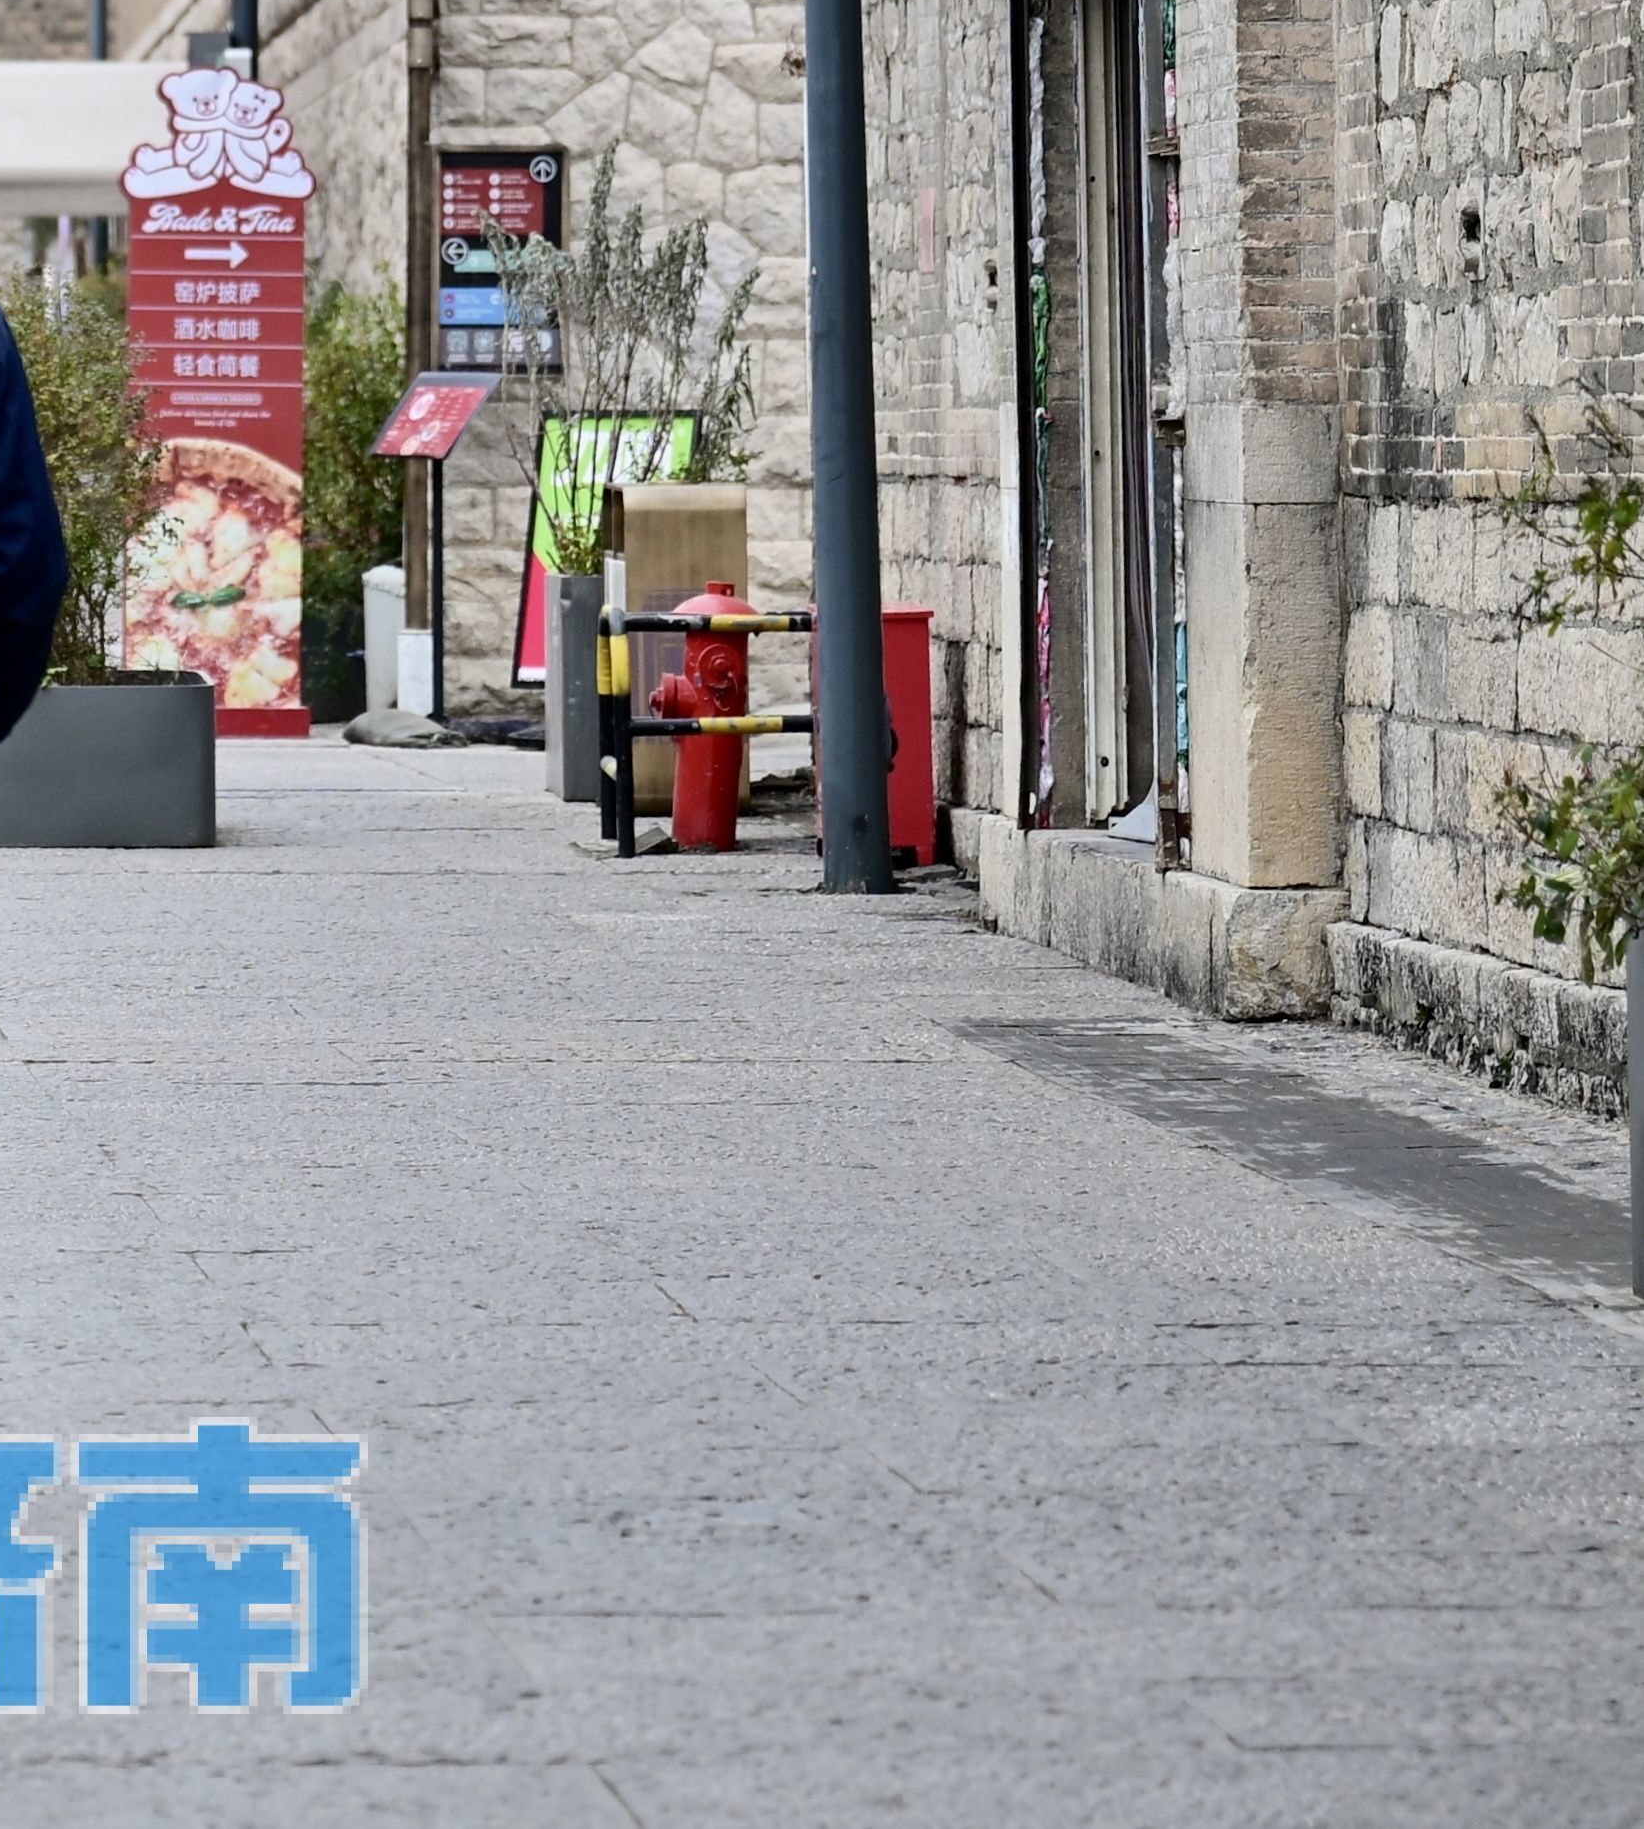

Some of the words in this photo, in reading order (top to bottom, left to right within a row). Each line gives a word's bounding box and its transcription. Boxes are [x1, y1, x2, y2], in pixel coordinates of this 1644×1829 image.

[214, 206, 238, 233] &
[238, 204, 297, 235] Tina
[174, 281, 260, 305] 窑炉披萨
[174, 318, 260, 341] 酒水咖啡
[173, 354, 259, 377] 轻食简餐
